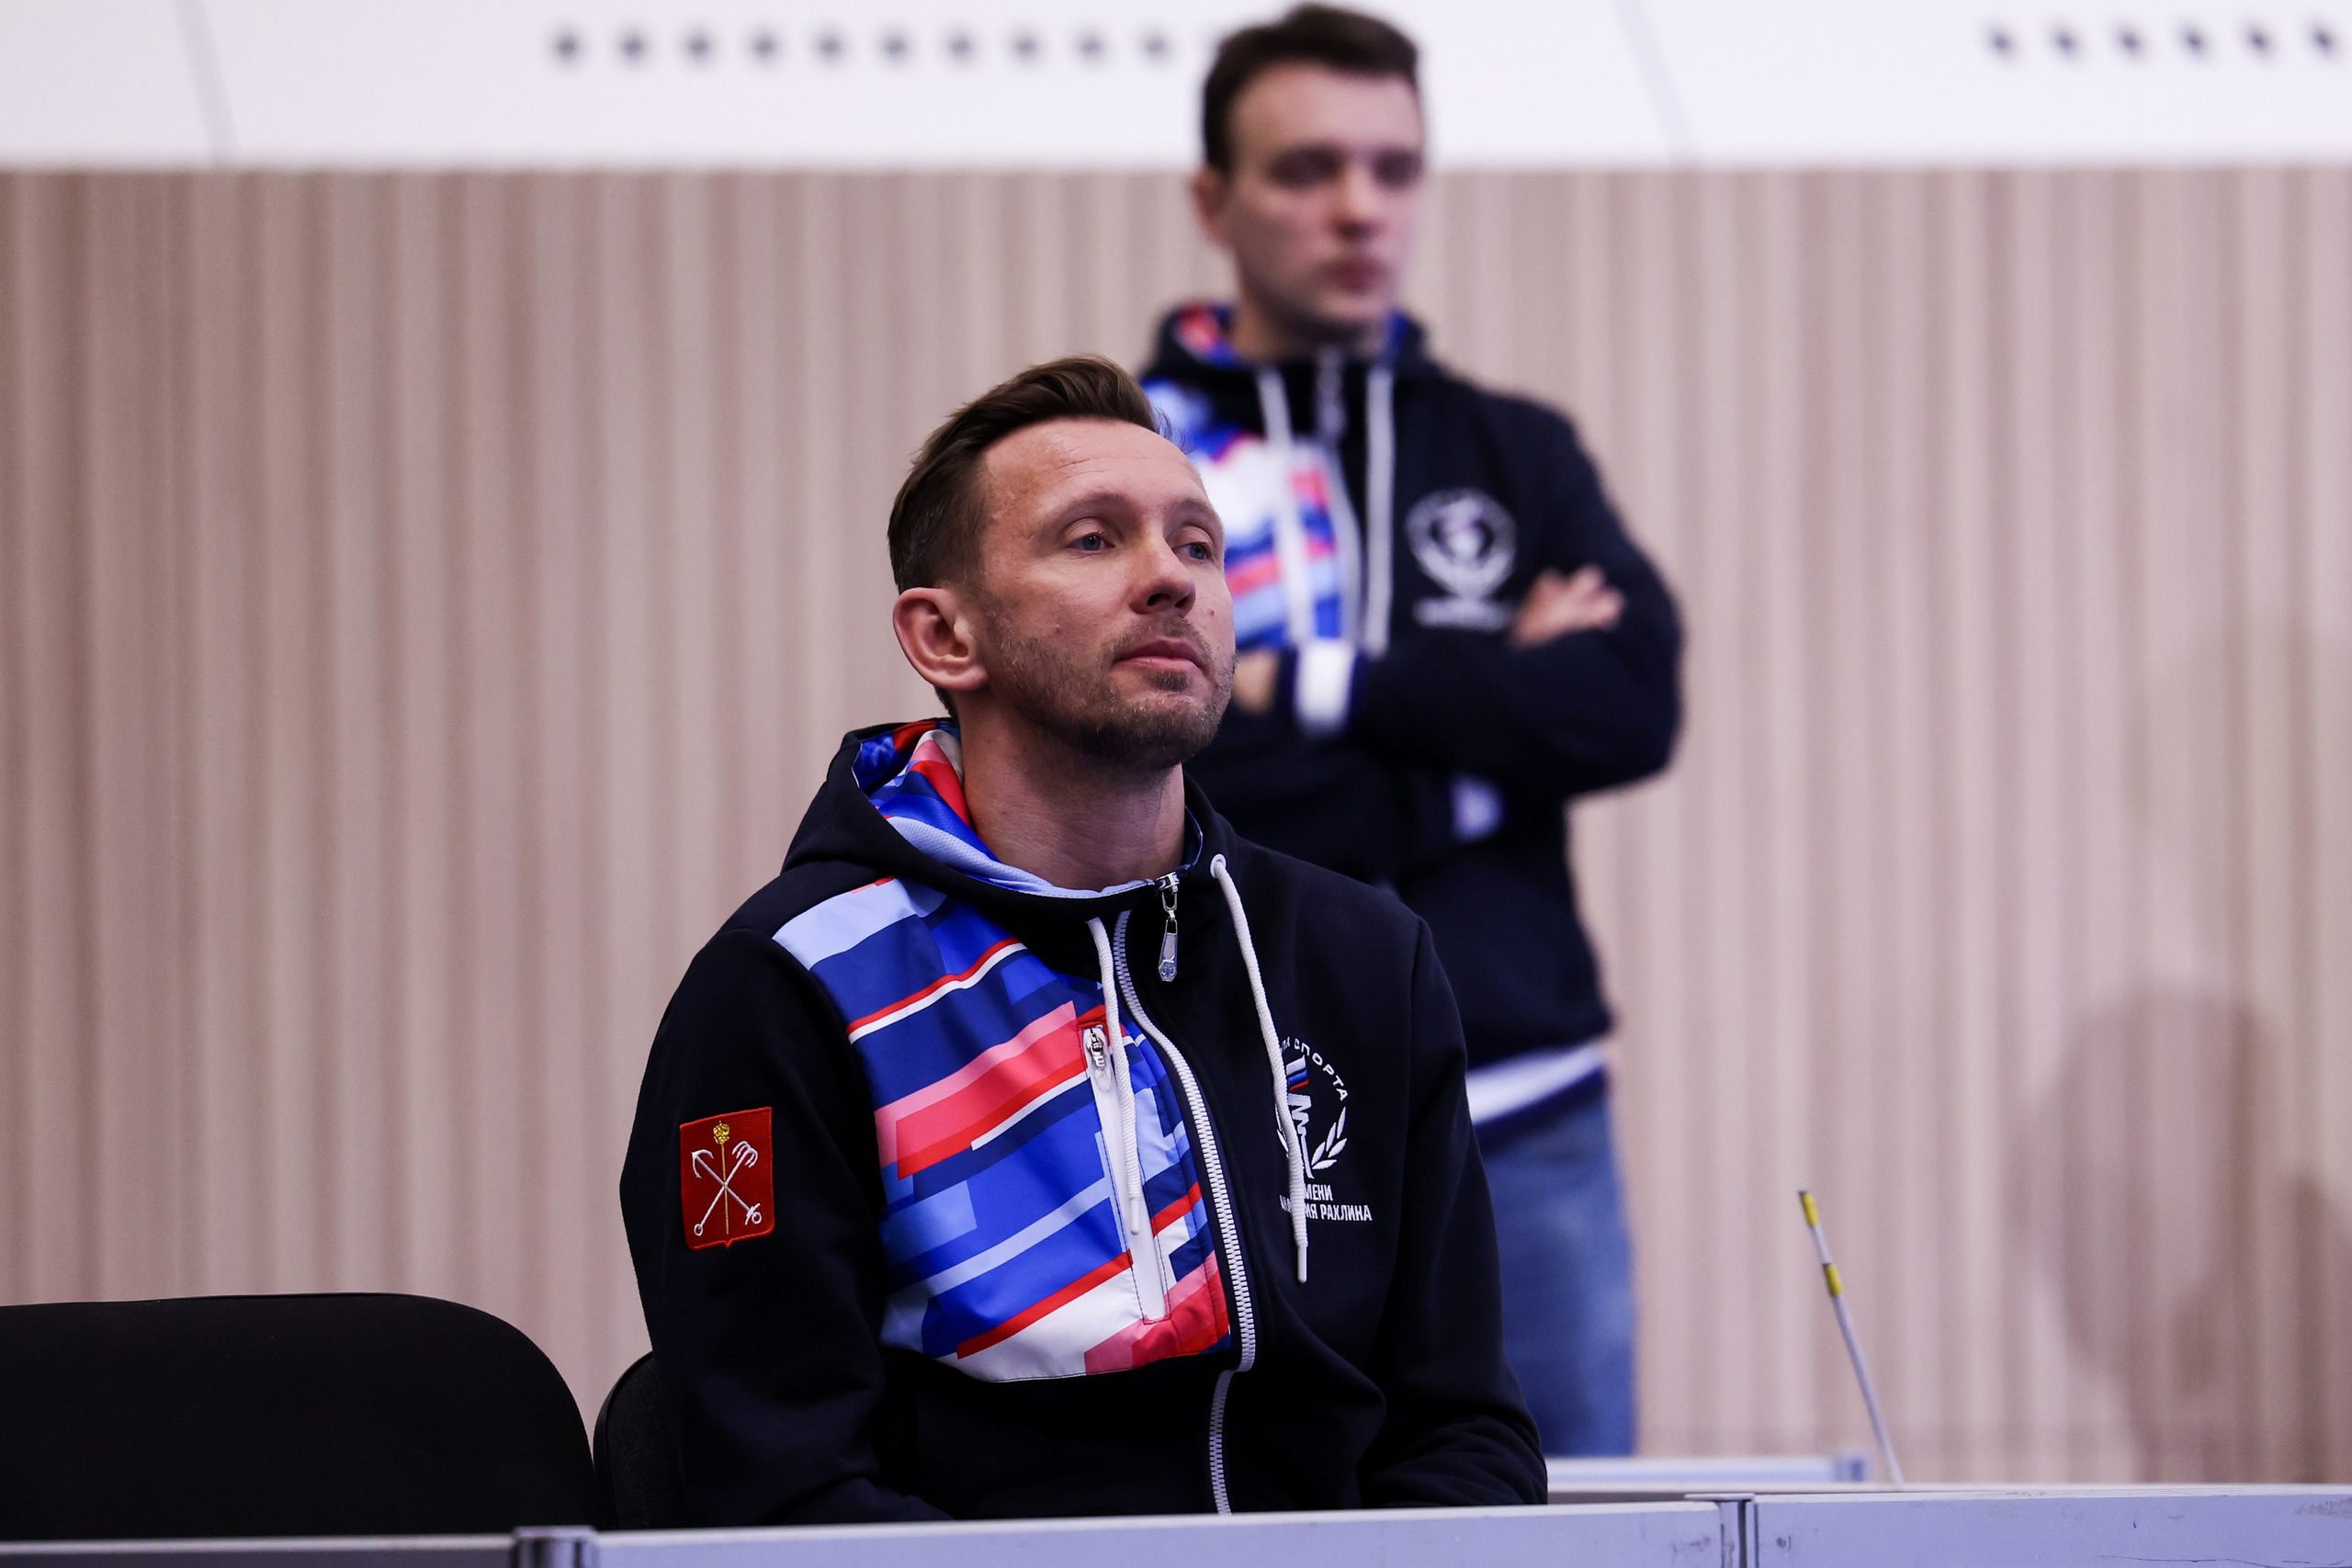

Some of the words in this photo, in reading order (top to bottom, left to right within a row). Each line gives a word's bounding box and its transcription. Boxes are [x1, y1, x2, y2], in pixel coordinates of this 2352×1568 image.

[1294, 1038, 1349, 1101] СПОРТА
[1304, 1183, 1333, 1201] МЕНИ
[1320, 1204, 1373, 1222] РАХЛИНА
